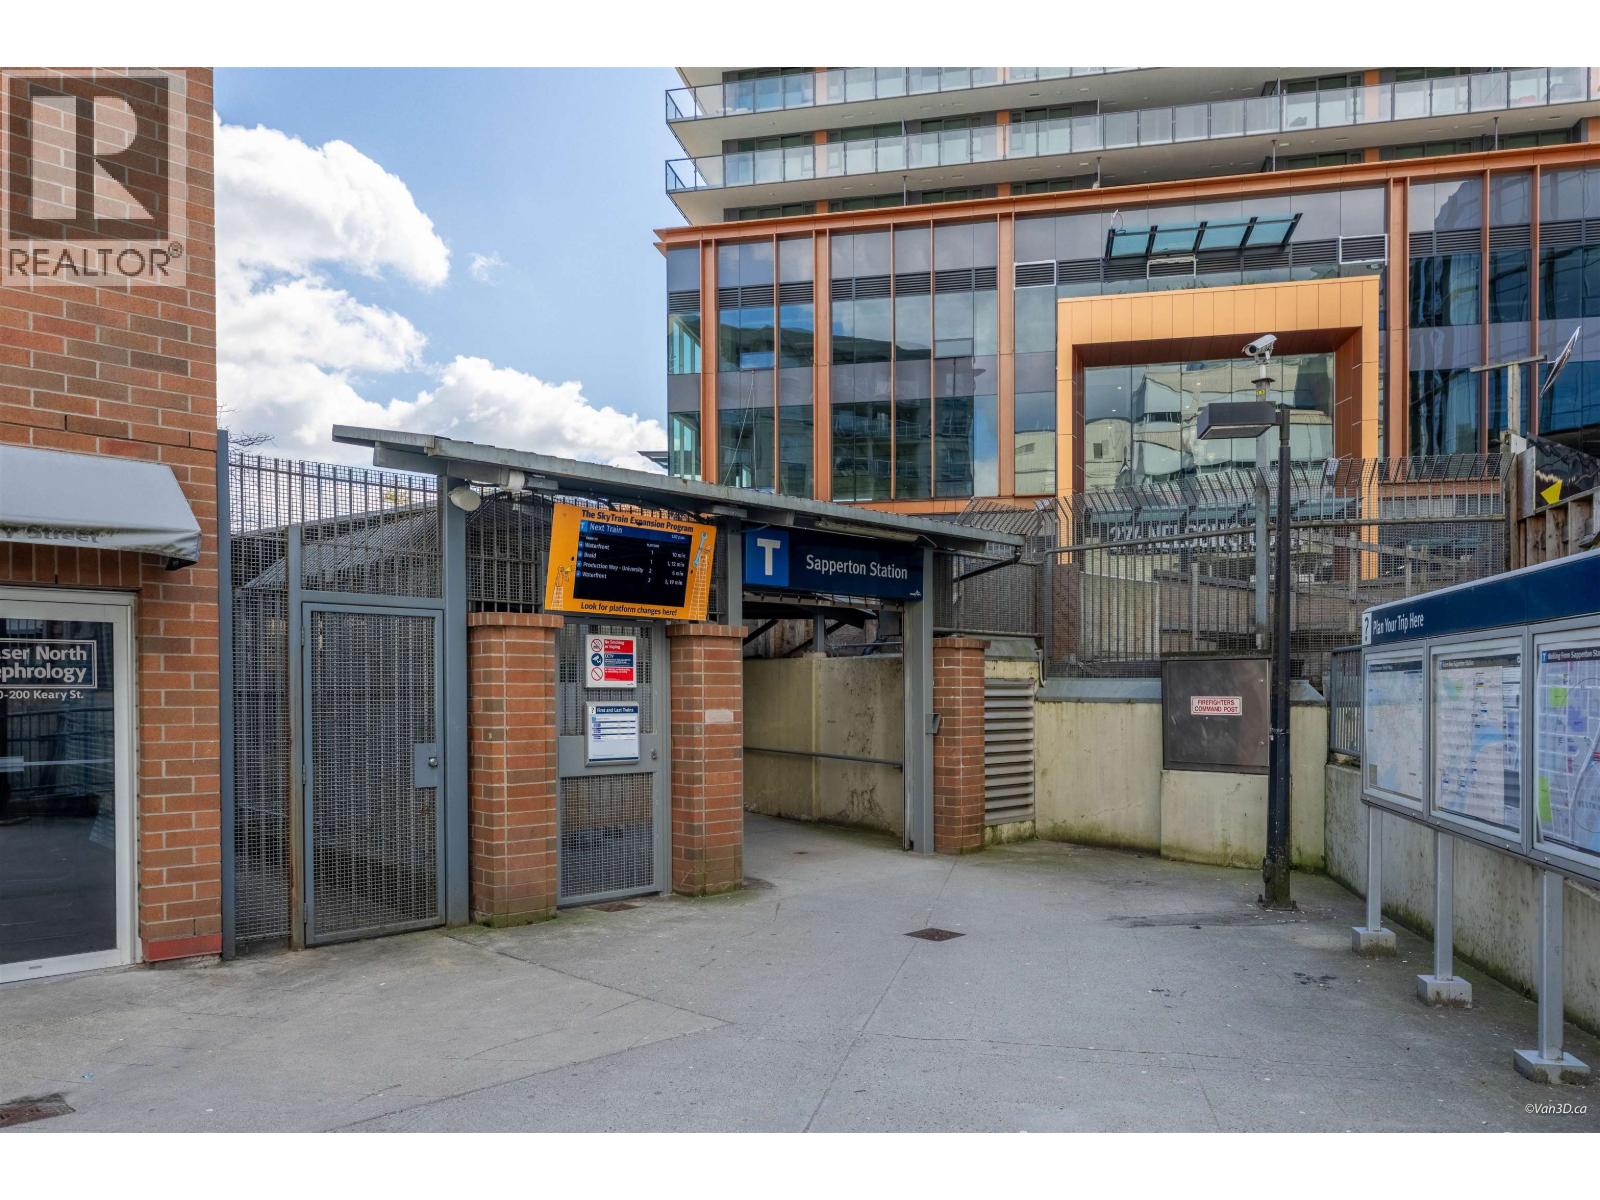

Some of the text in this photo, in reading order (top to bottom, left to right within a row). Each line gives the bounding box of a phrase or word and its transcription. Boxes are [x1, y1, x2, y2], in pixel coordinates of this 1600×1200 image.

[582, 510, 694, 533] The SkyTrain Expansion Program
[590, 523, 605, 532] Next
[607, 525, 623, 534] Train
[806, 554, 908, 580] Sapperton Station
[581, 602, 596, 610] Look
[599, 602, 608, 610] for
[608, 604, 636, 612] platform
[637, 606, 660, 616] changes
[1372, 612, 1424, 635] Plan Your Trip Here
[0, 645, 86, 660] ser North
[33, 690, 66, 701] Keary
[69, 690, 84, 699] St.
